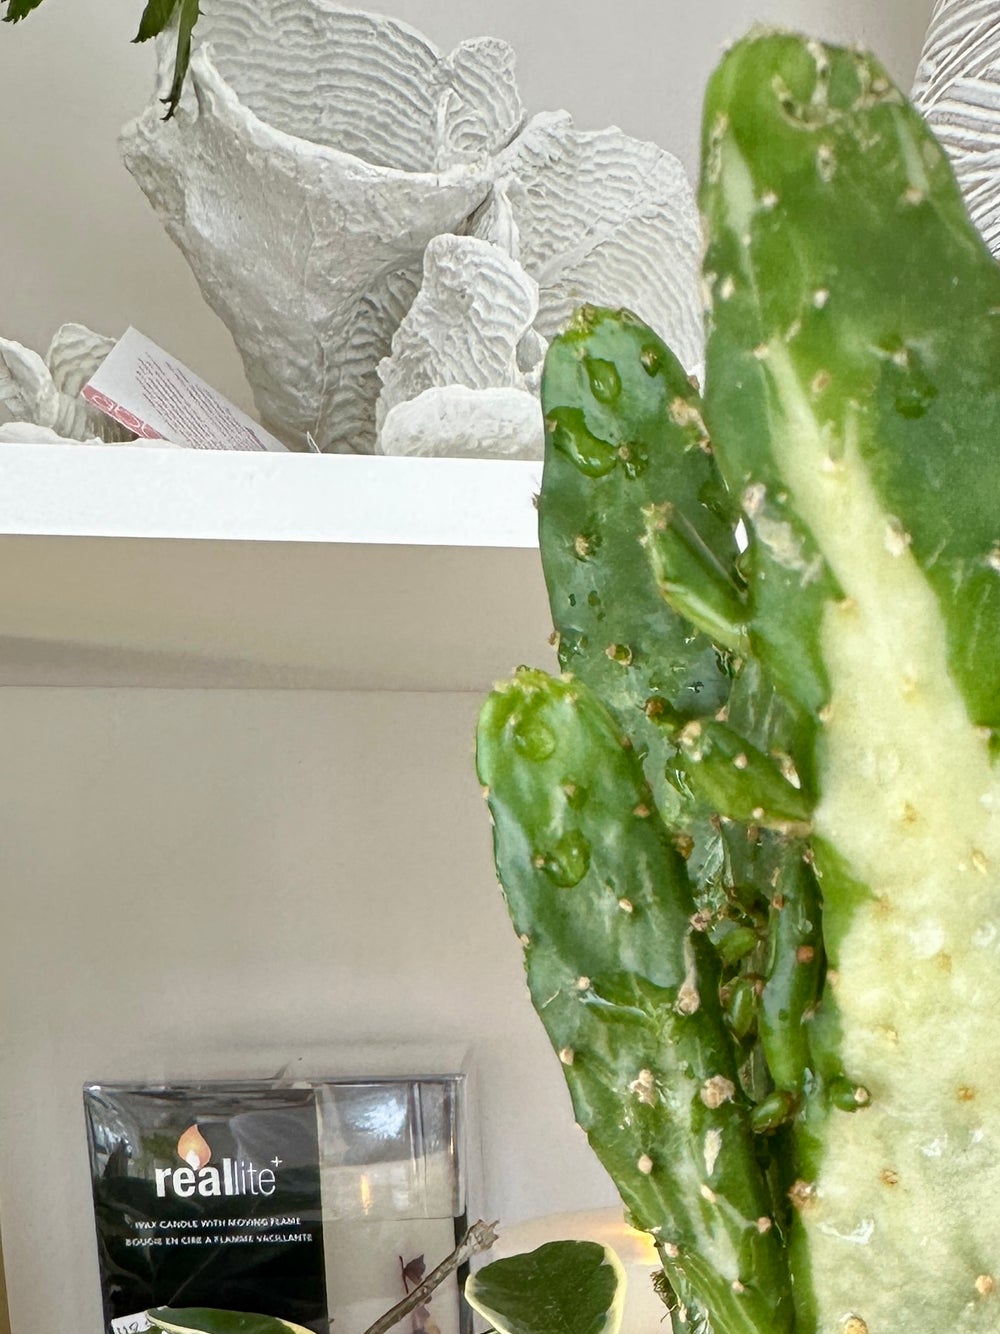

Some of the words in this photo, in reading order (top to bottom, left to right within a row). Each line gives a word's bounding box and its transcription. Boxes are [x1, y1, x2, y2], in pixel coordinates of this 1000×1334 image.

[134, 1221, 157, 1230] WAX
[159, 1219, 199, 1229] CANDLE
[200, 1218, 226, 1228] WITH
[227, 1217, 268, 1227] MOVING
[270, 1216, 301, 1226] FLAME
[125, 1237, 163, 1247] BOUGIE
[165, 1236, 179, 1245] EN
[181, 1235, 202, 1245] CIRE
